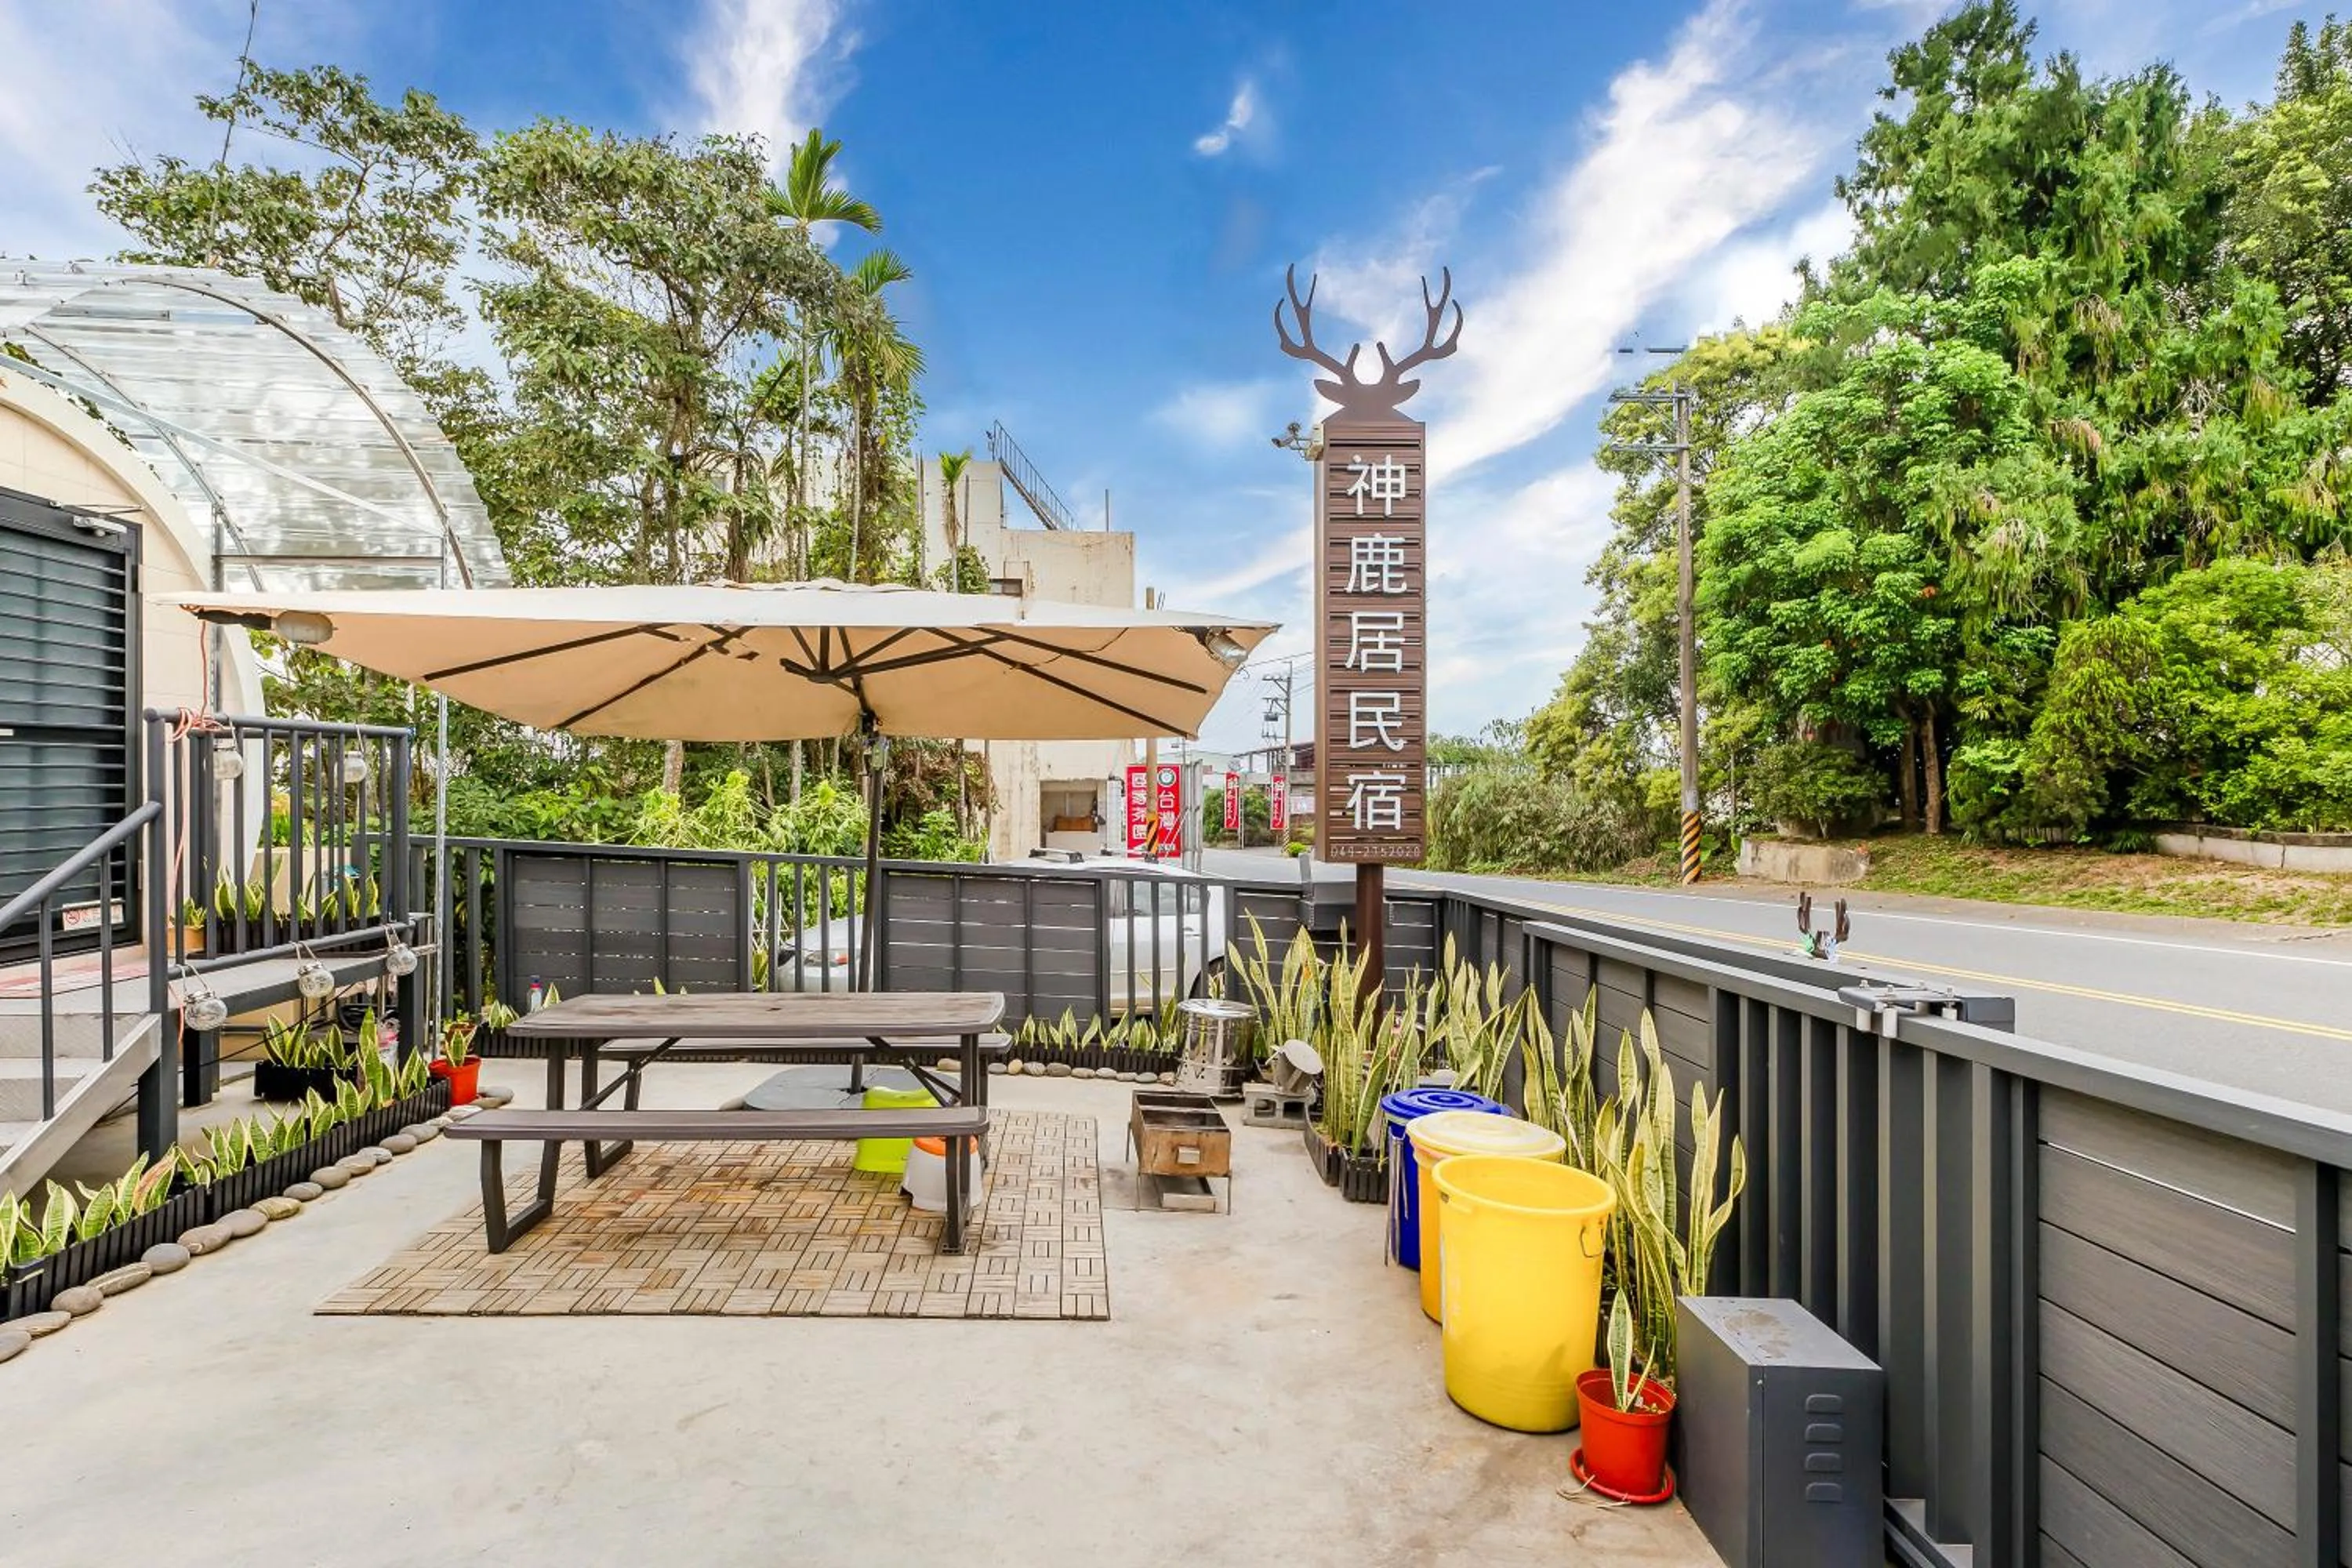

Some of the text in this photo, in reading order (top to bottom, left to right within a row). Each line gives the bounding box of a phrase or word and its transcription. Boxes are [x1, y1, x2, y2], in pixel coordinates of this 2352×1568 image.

[1345, 454, 1407, 829] 神鹿居民宿
